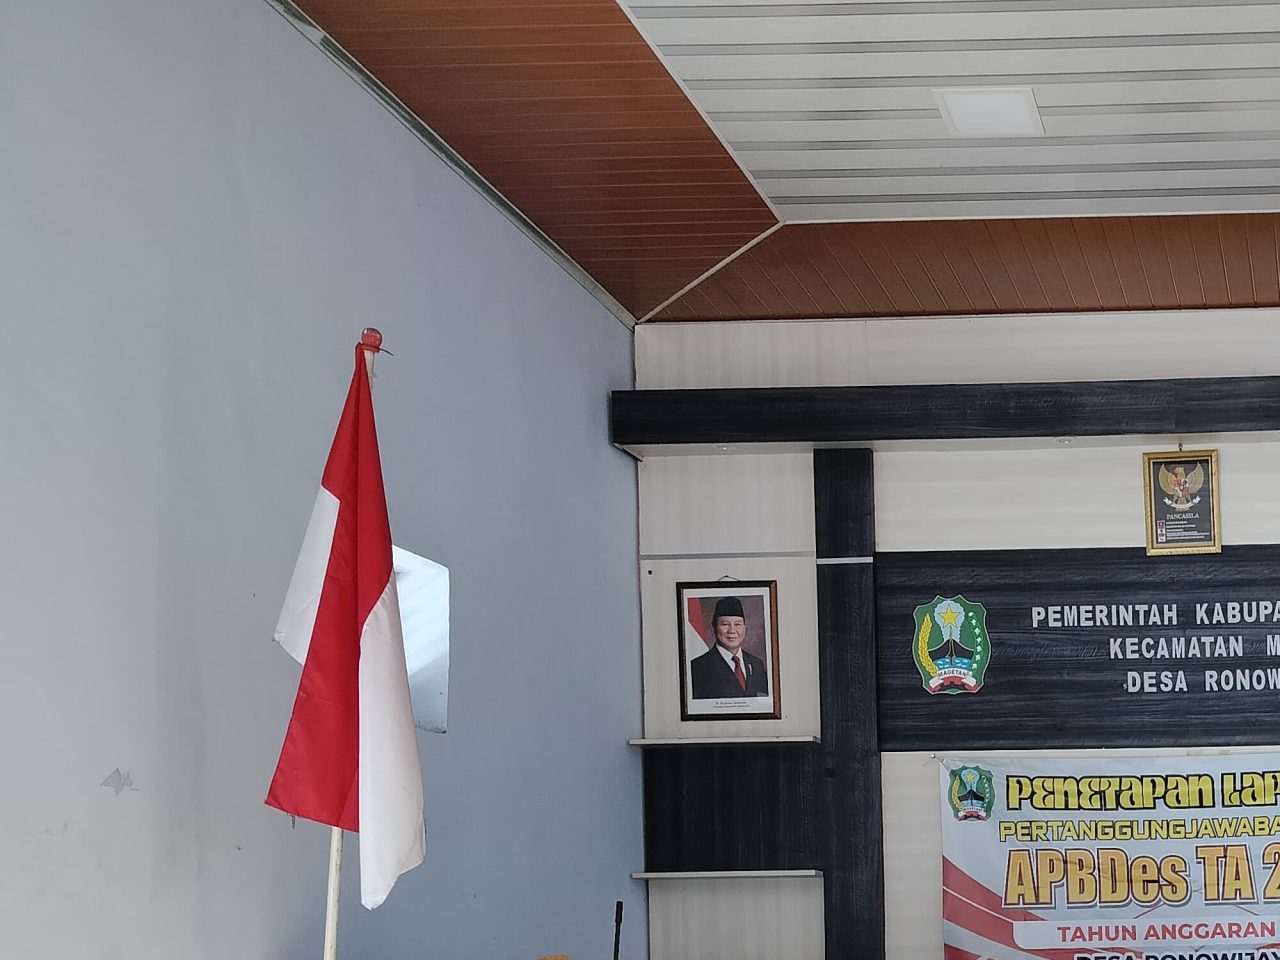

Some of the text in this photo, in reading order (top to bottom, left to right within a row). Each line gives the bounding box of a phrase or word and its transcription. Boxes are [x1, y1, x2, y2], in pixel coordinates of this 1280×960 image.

[1166, 512, 1199, 520] PANCASILA
[1031, 603, 1178, 628] PEMERINTAH
[1109, 635, 1244, 659] KECAMATAN
[1127, 670, 1188, 693] DESA
[1006, 774, 1215, 811] PENETAPAN
[1003, 847, 1192, 907] APBDes
[1195, 844, 1257, 902] TA
[1057, 924, 1137, 942] TAHUN
[1143, 921, 1276, 941] ANGGARAN
